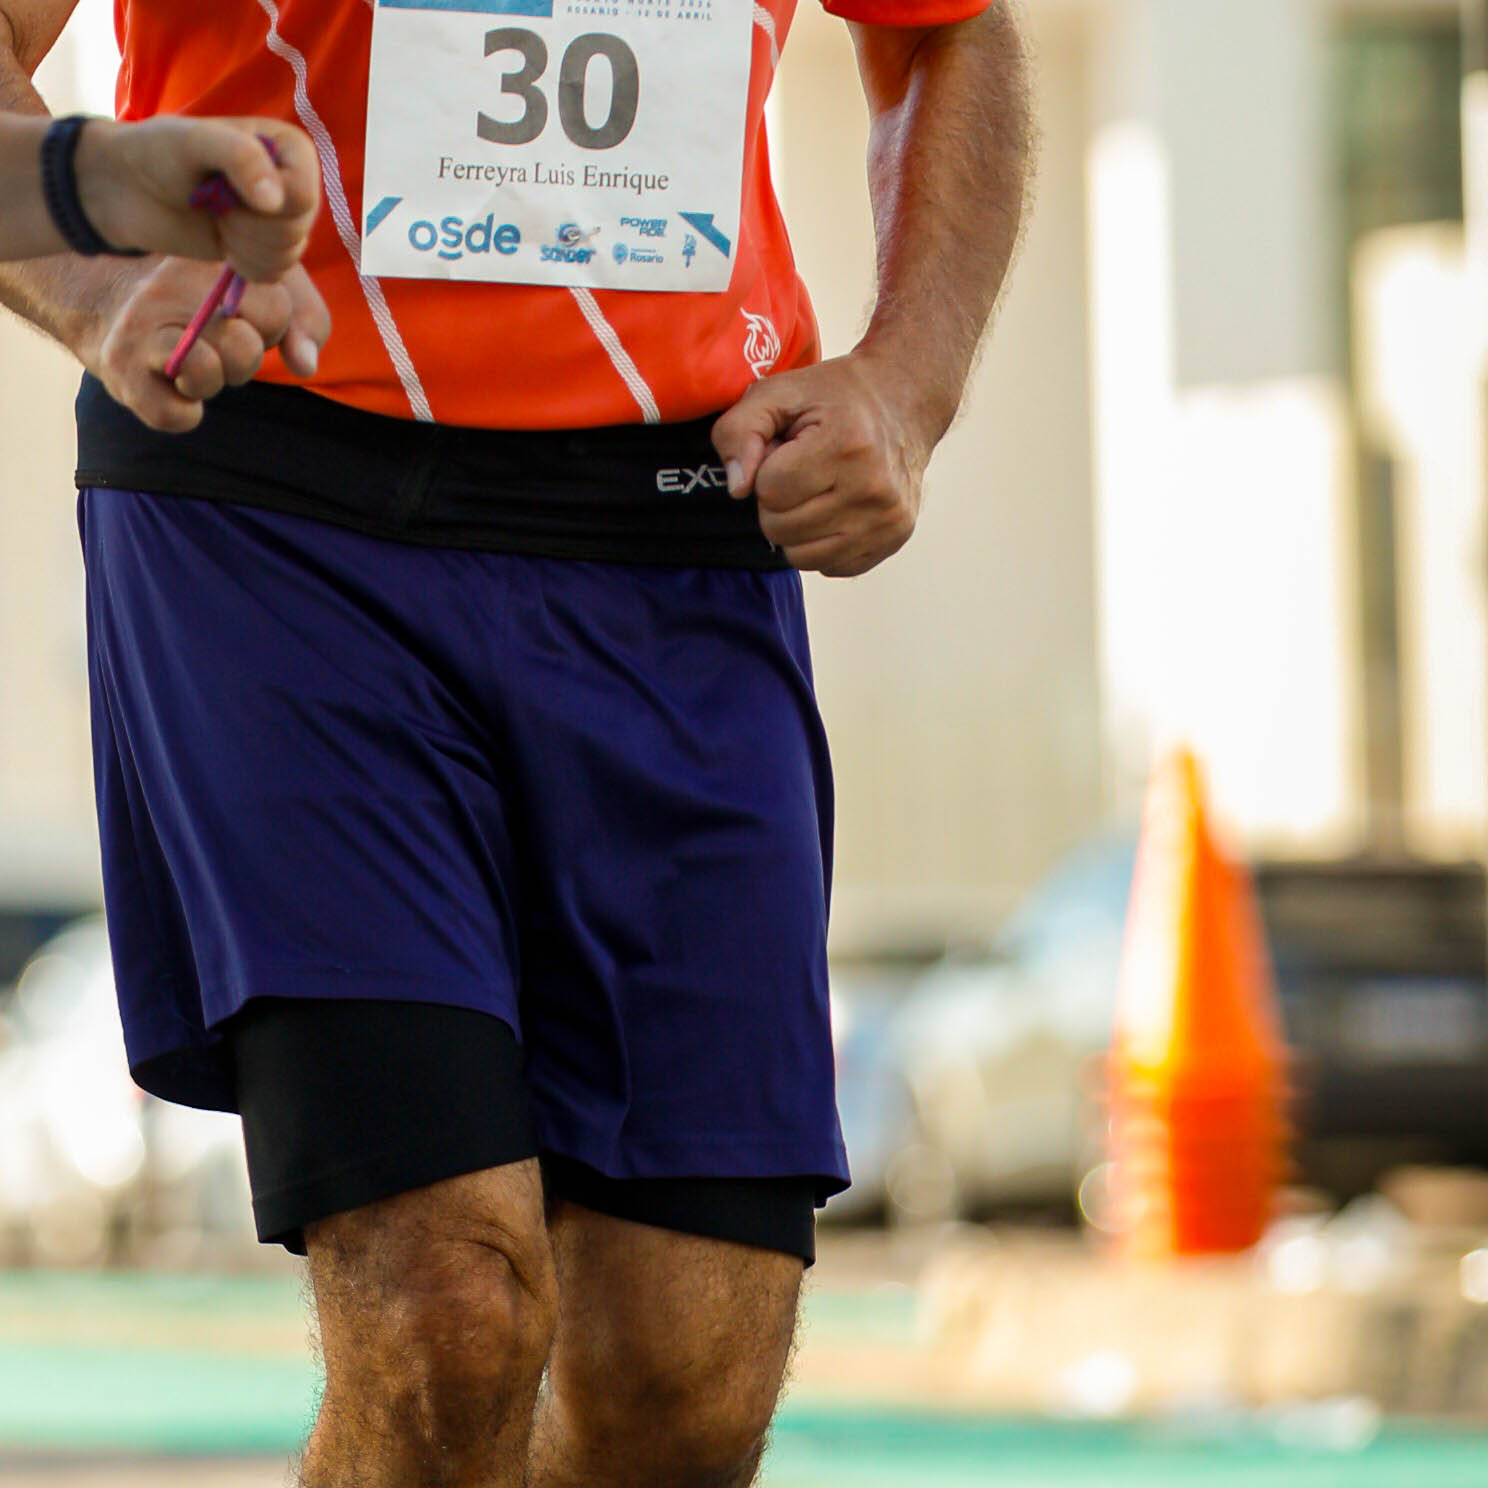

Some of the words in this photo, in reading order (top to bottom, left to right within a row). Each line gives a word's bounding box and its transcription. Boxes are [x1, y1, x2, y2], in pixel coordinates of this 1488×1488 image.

[567, 5, 618, 16] ROSARIO
[677, 11, 712, 21] ABRIL
[477, 27, 639, 150] 30
[437, 156, 527, 187] Ferreyra
[534, 162, 575, 185] Luis
[583, 164, 669, 195] Enrique
[408, 212, 521, 261] osde
[630, 252, 664, 263] Rosario
